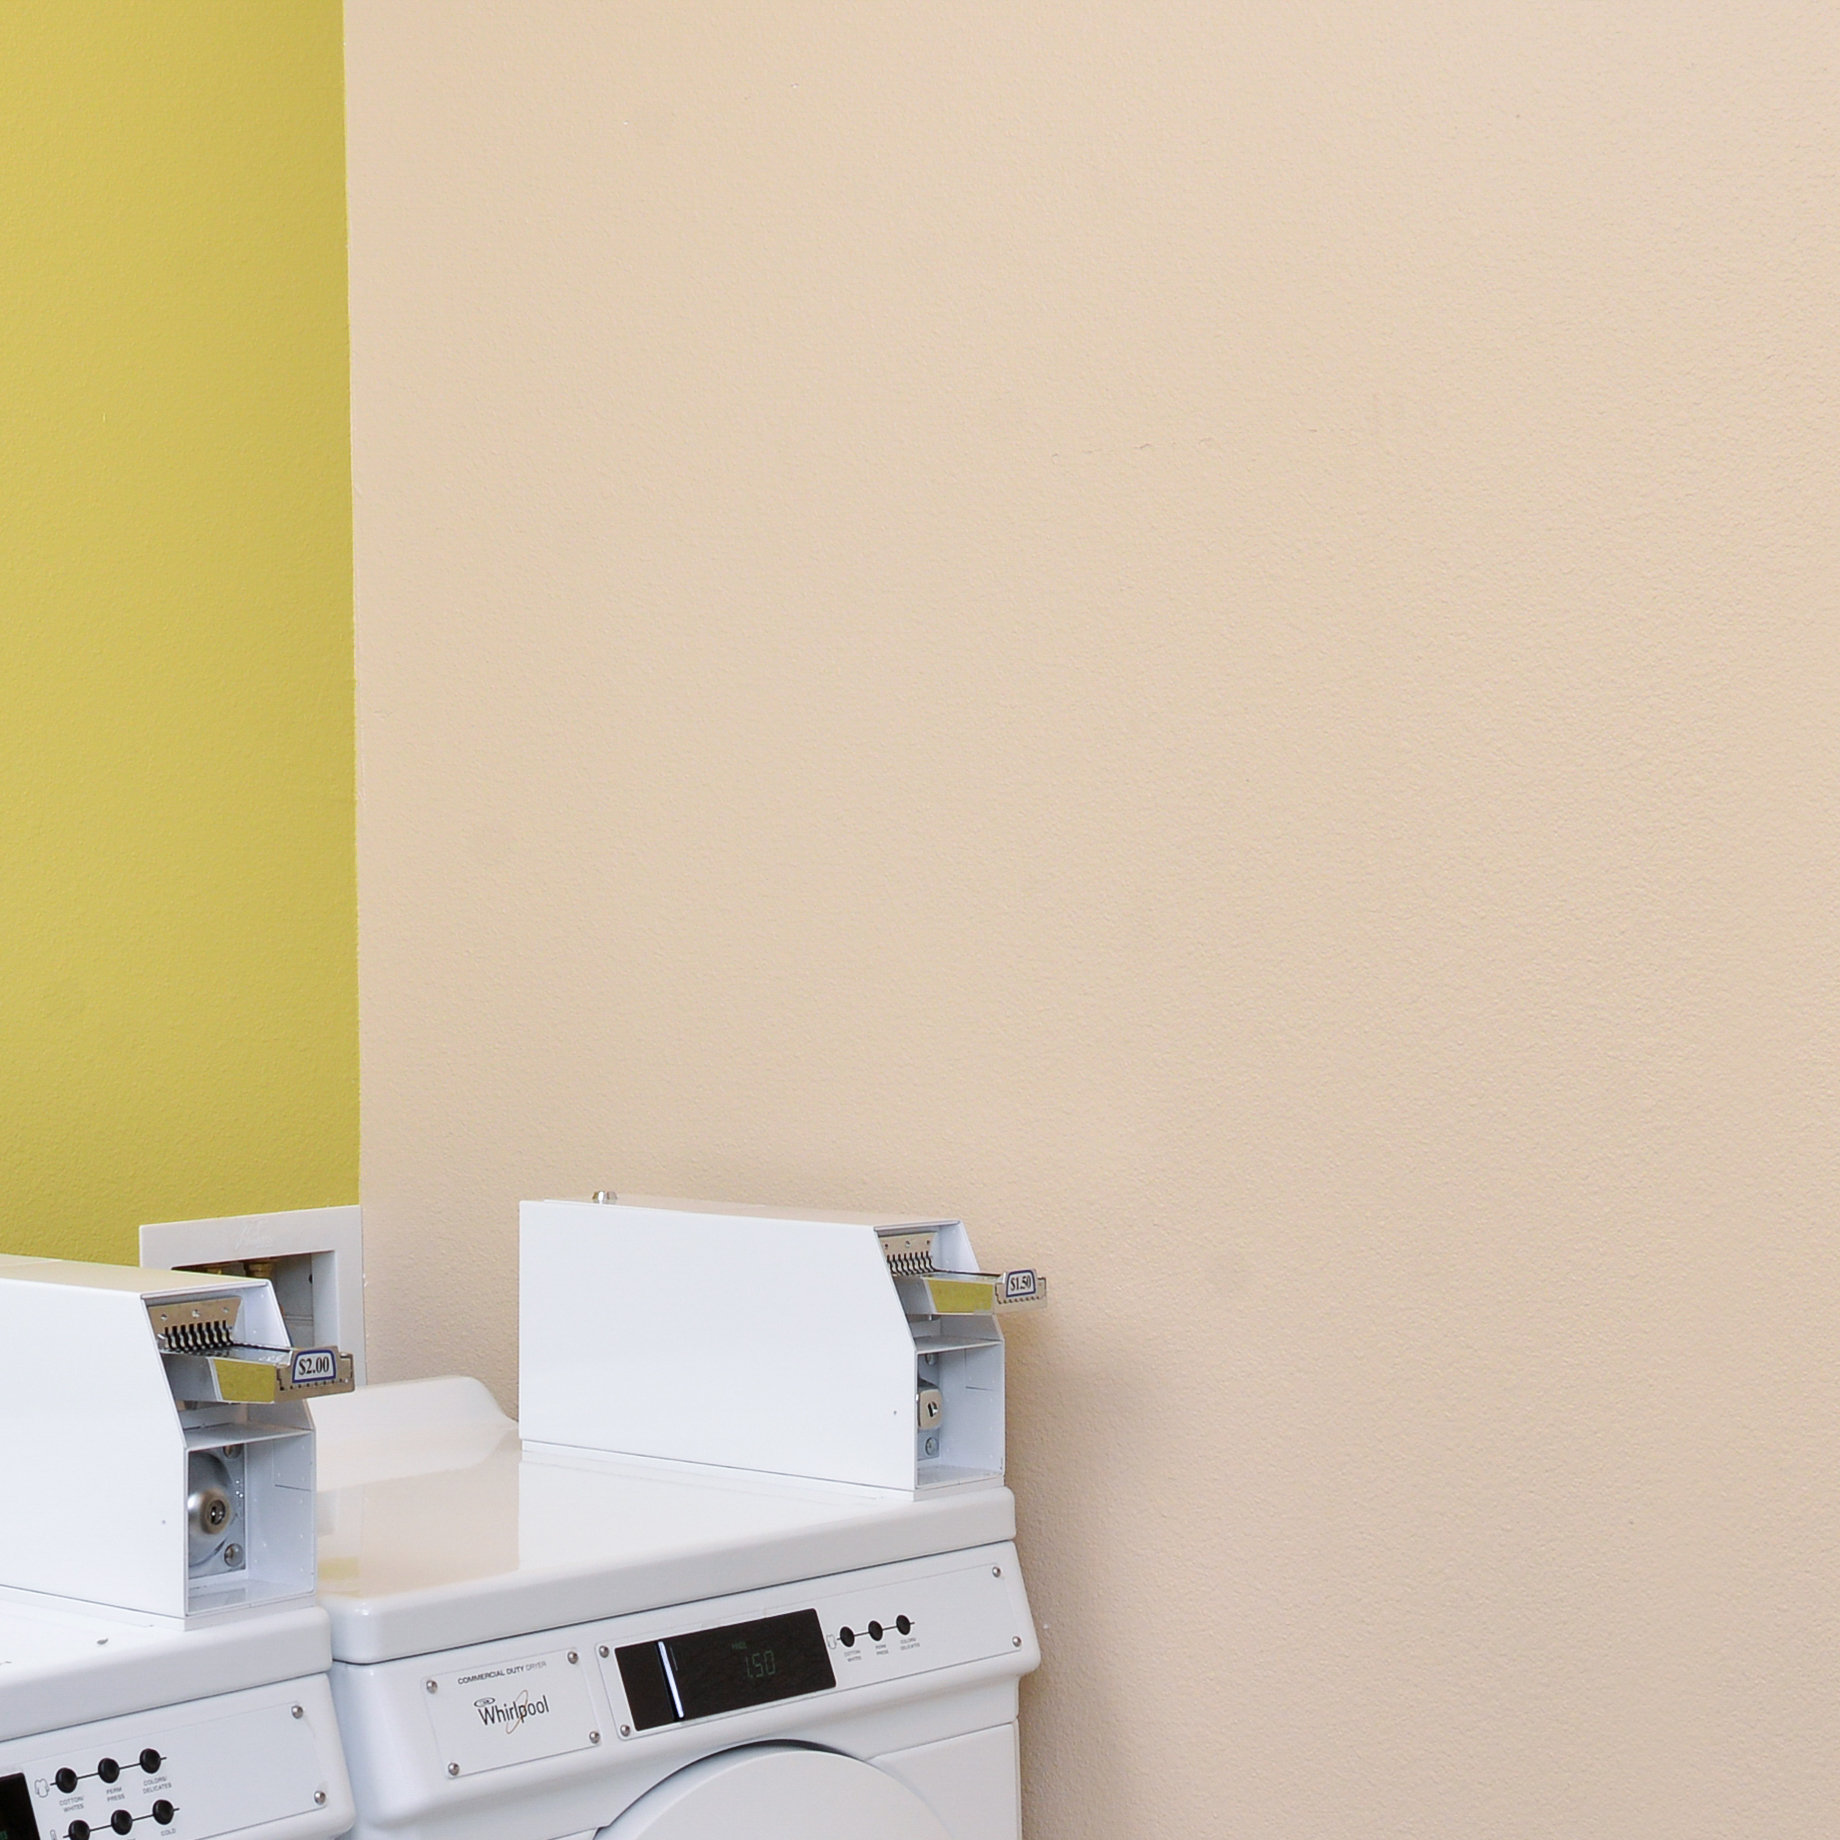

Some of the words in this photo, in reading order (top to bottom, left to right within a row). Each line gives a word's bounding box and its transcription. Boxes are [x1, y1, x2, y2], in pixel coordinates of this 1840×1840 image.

[1010, 1275, 1032, 1291] $1.50
[298, 1356, 330, 1376] $2.00
[457, 1670, 505, 1685] COMMERCIAL
[506, 1665, 525, 1675] DUTY
[477, 1694, 550, 1727] Whirlpool
